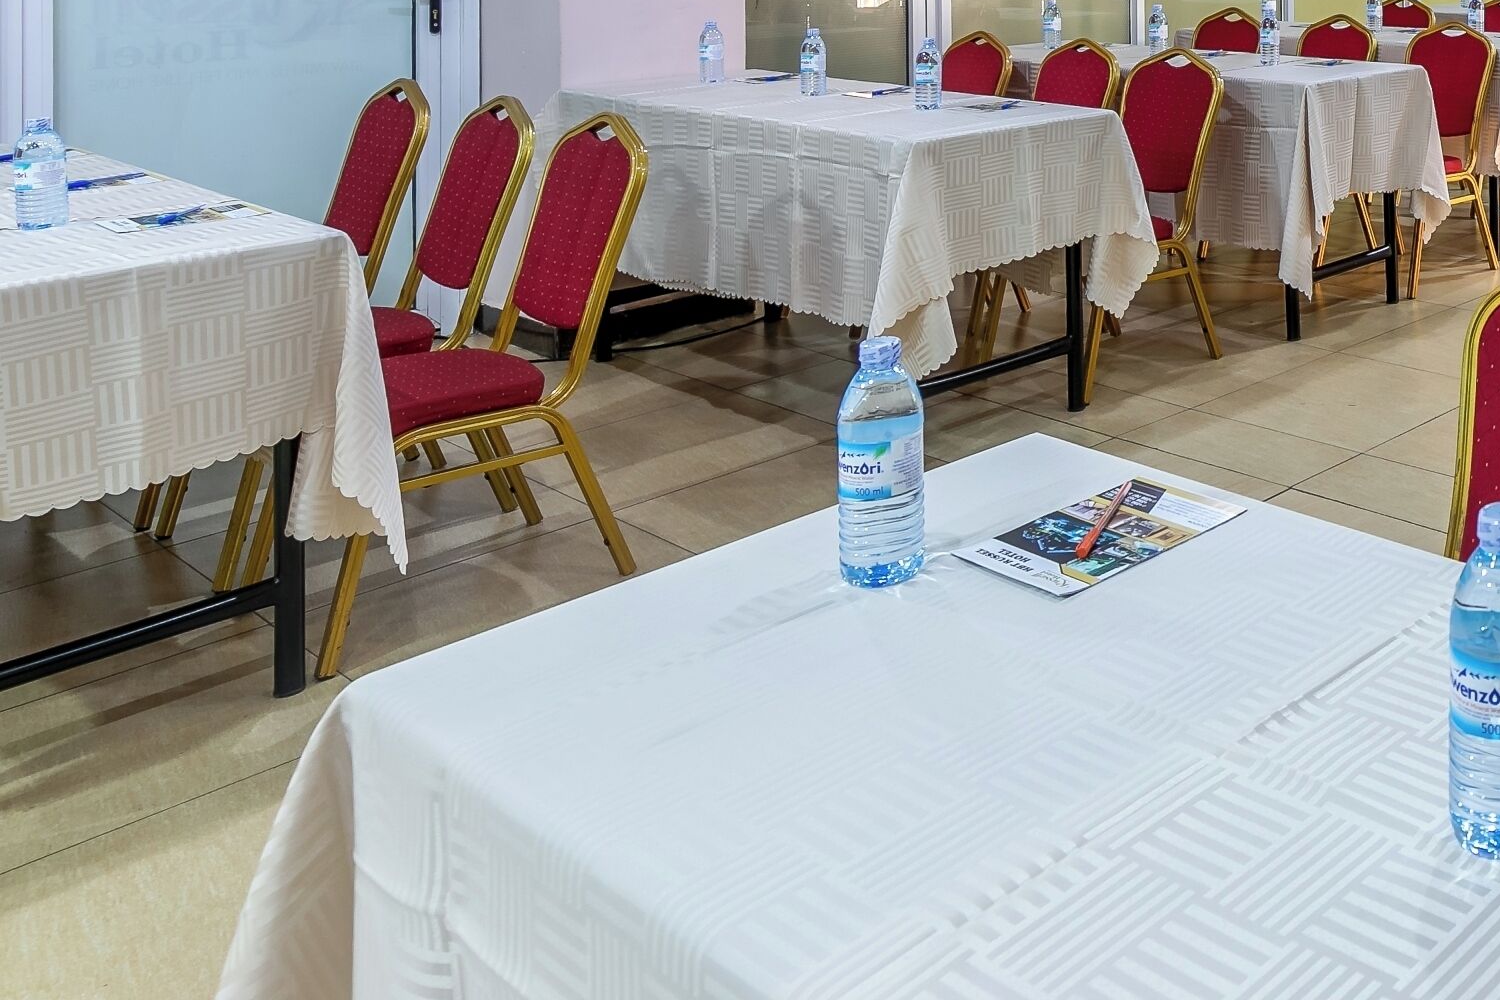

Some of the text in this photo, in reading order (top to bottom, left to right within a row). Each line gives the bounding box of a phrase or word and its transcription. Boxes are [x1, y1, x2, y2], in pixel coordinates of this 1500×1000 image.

[838, 461, 881, 475] enzori
[855, 486, 884, 497] 500 ml
[998, 548, 1031, 563] HOTEL
